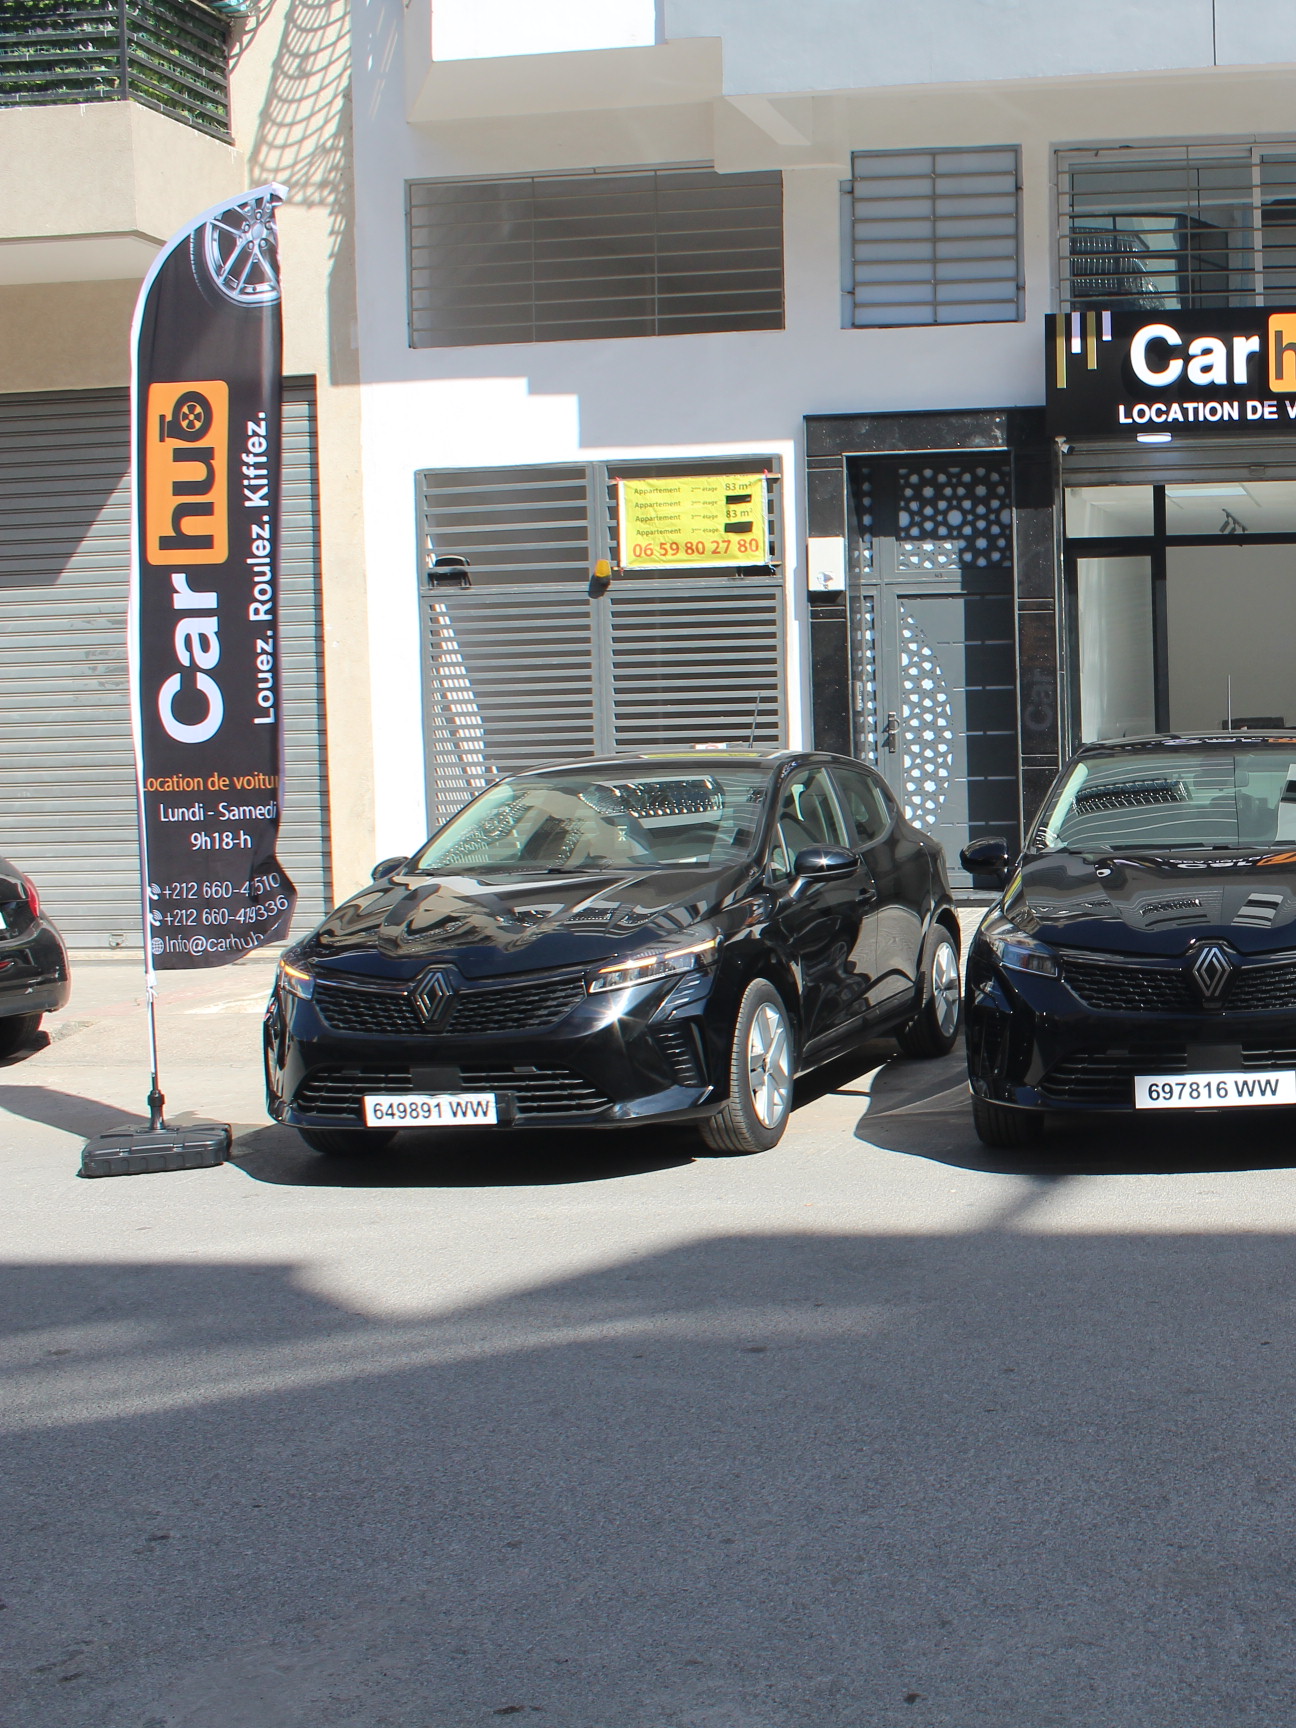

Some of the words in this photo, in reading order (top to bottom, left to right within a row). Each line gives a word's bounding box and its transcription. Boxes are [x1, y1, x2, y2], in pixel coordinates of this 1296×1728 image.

[1129, 322, 1260, 387] Car
[1118, 401, 1240, 424] LOCATION
[1246, 400, 1279, 420] DE
[242, 411, 270, 508] Kiffez.
[158, 390, 216, 551] hub
[633, 486, 681, 496] Appartement
[725, 482, 737, 491] 83
[634, 500, 681, 509] Appartement
[635, 514, 681, 523] Appartement
[725, 509, 738, 519] 83
[636, 527, 682, 537] Appartement
[632, 543, 654, 558] 06
[659, 541, 680, 557] 59
[684, 541, 706, 555] 80
[711, 540, 731, 555] 27
[737, 538, 759, 553] 80
[246, 514, 273, 621] Roulez.
[158, 572, 225, 744] Car
[253, 630, 275, 725] Louez.
[143, 773, 203, 792] ocation
[207, 771, 230, 791] de
[160, 802, 204, 822] Lundi
[218, 801, 277, 820] Samedi
[191, 830, 252, 850] 9h18-h
[162, 882, 198, 899] +212
[164, 908, 197, 926] +212
[203, 894, 288, 926] 660-419336
[1148, 1081, 1228, 1101] 697816
[1234, 1079, 1280, 1098] WW
[373, 1101, 442, 1120] 649891
[448, 1100, 490, 1118] WW
